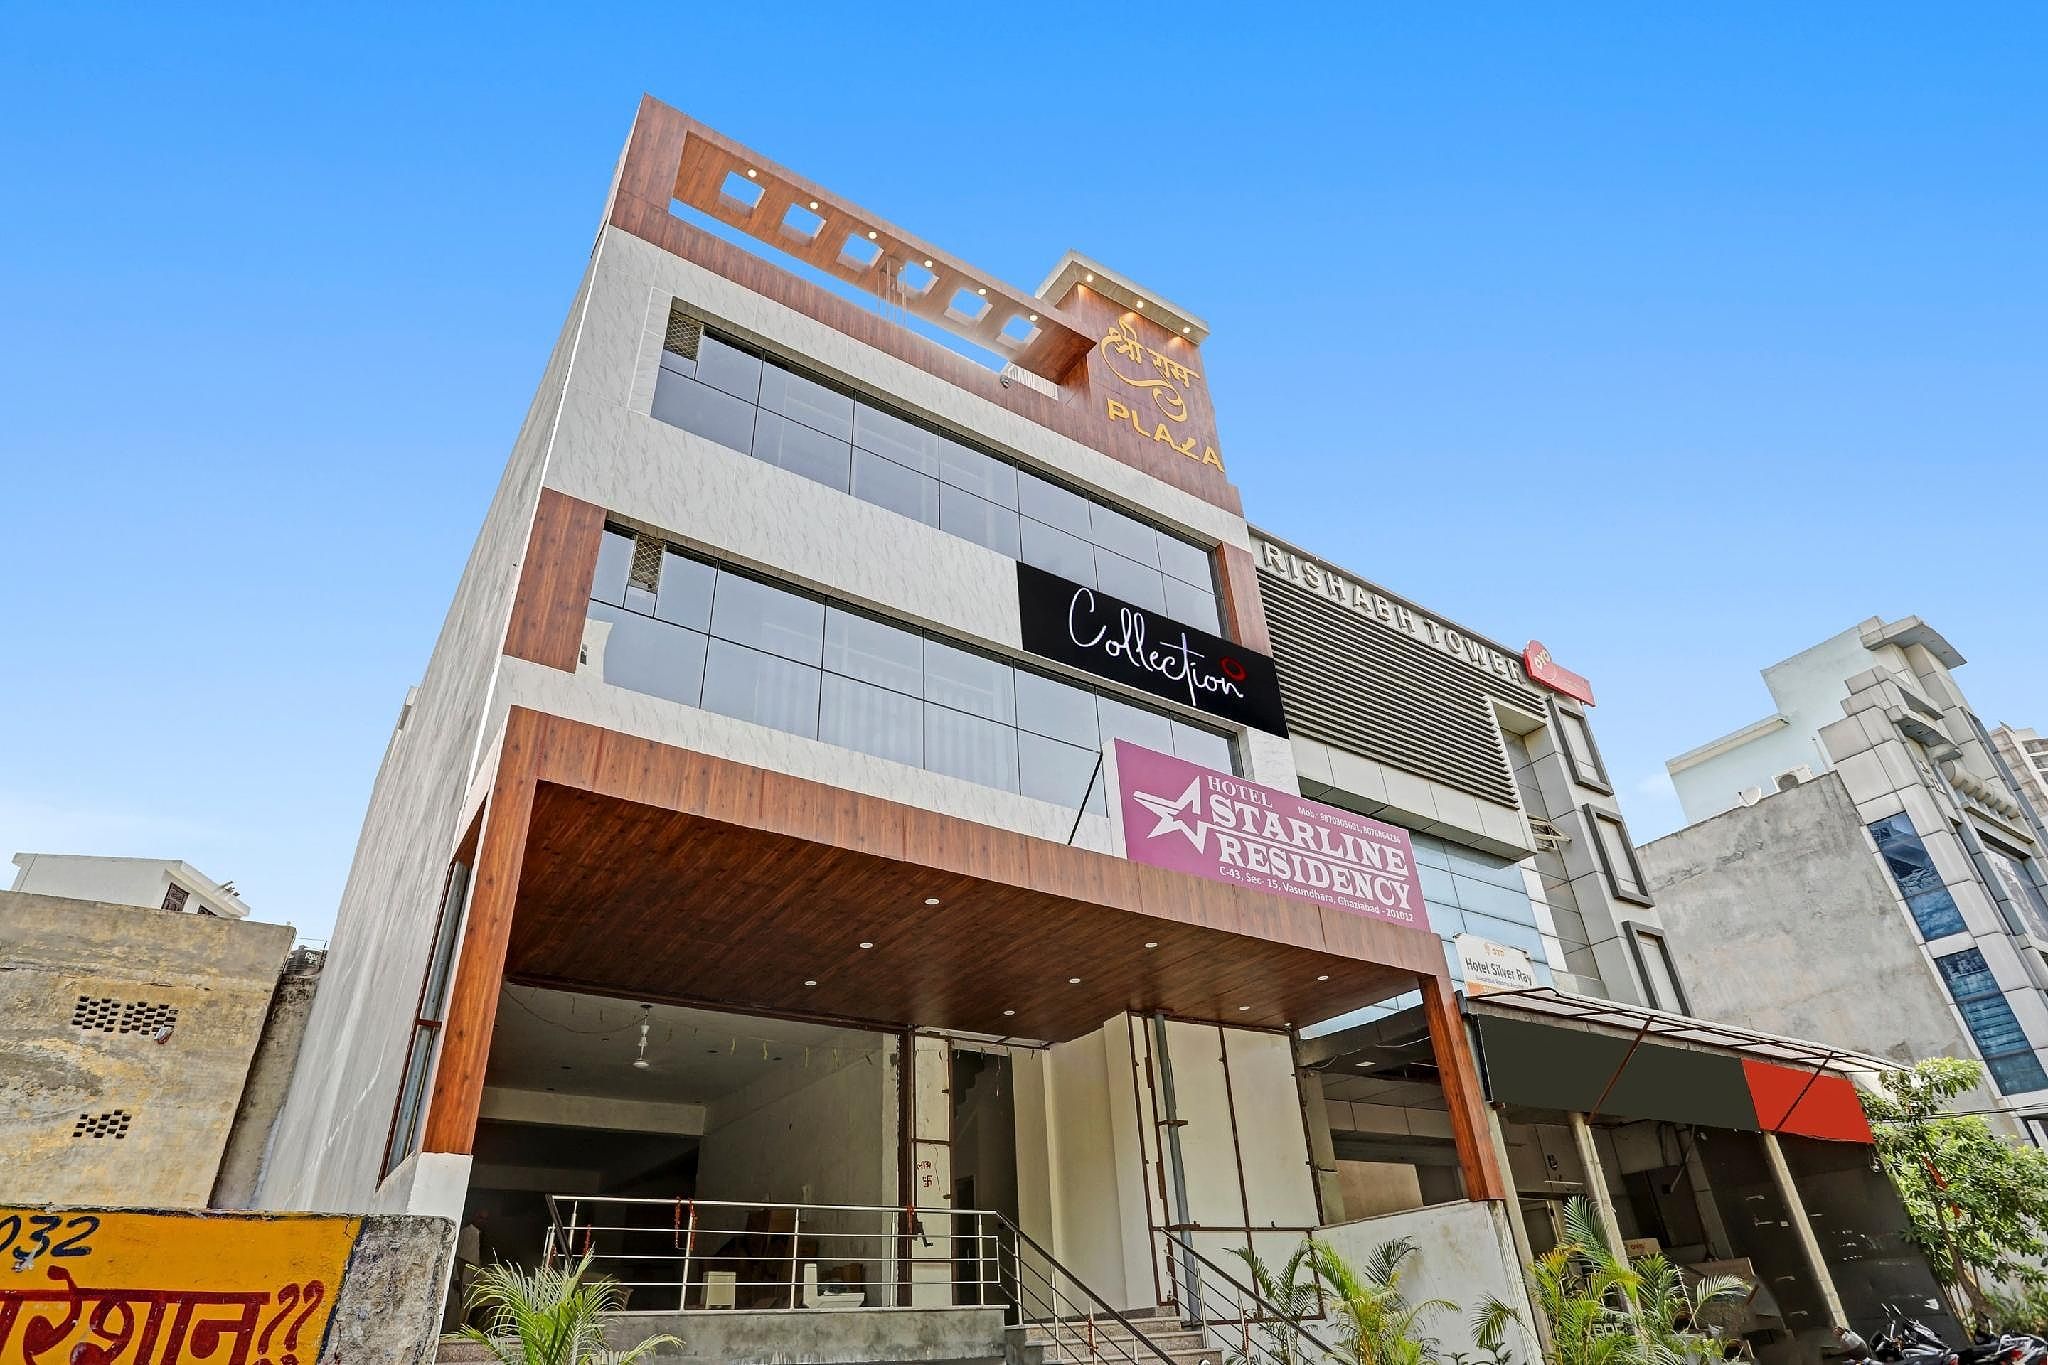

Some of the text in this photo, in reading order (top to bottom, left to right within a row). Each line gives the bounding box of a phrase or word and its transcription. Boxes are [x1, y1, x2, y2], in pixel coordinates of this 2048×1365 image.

[1107, 398, 1225, 473] PLAZA
[1069, 587, 1244, 707] Collection
[1261, 540, 1526, 684] RISHABH TOWER
[1208, 775, 1273, 807] HOTEL
[1210, 794, 1409, 876] STARLINE
[1215, 832, 1411, 909] RESIDENCY
[1219, 866, 1244, 881] C-43,
[1266, 878, 1281, 891] 15,
[1282, 881, 1336, 904] Vasundhara,
[1338, 896, 1380, 915] Ghaziabad
[1465, 957, 1490, 975] Hotel
[1490, 962, 1514, 980] Silver
[1516, 968, 1533, 986] Ray
